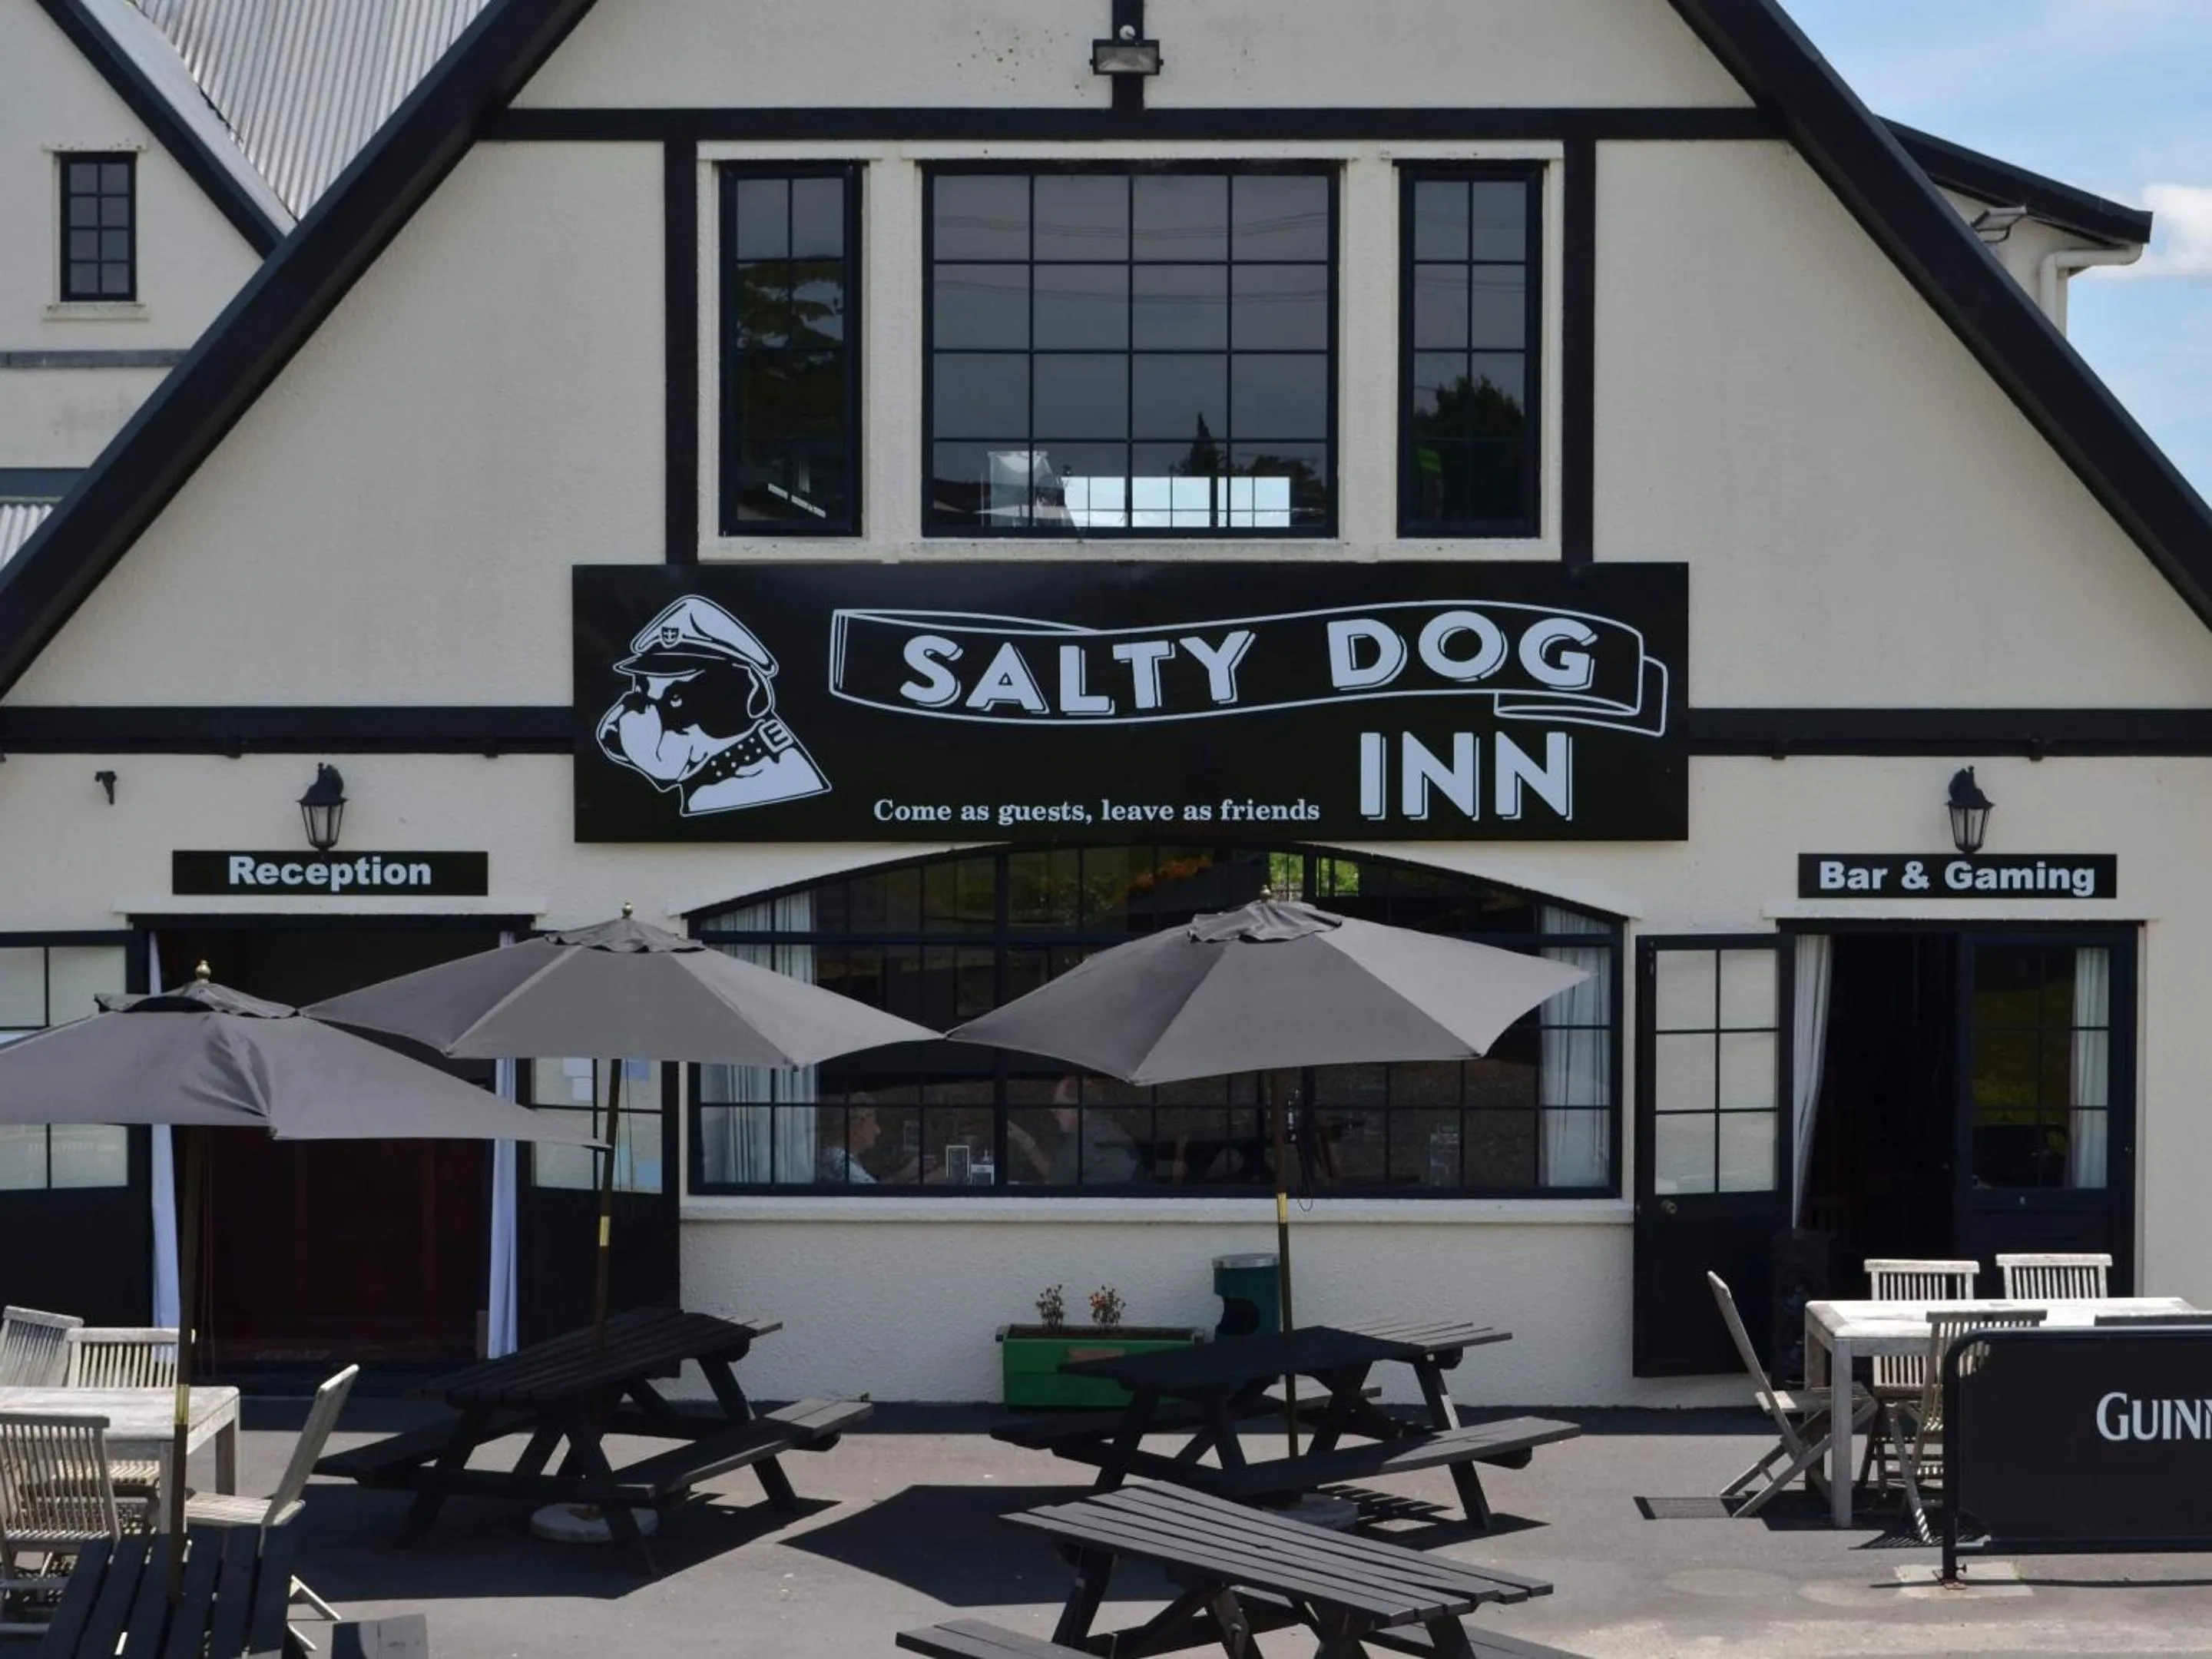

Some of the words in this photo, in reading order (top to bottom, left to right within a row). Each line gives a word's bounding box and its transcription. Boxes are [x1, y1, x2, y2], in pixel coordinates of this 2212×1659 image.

[899, 631, 1256, 715] SALTY
[1326, 610, 1598, 690] DOG
[1360, 731, 1573, 821] INN
[874, 799, 952, 821] Come
[961, 805, 989, 821] as
[998, 801, 1092, 826] guests,
[1101, 799, 1174, 821] leave
[1183, 805, 1212, 821] as
[1220, 798, 1320, 821] friends
[229, 856, 432, 892] Reception
[1820, 861, 1889, 890] Bar
[1901, 860, 1930, 890] &
[1945, 861, 2095, 897] Gaming
